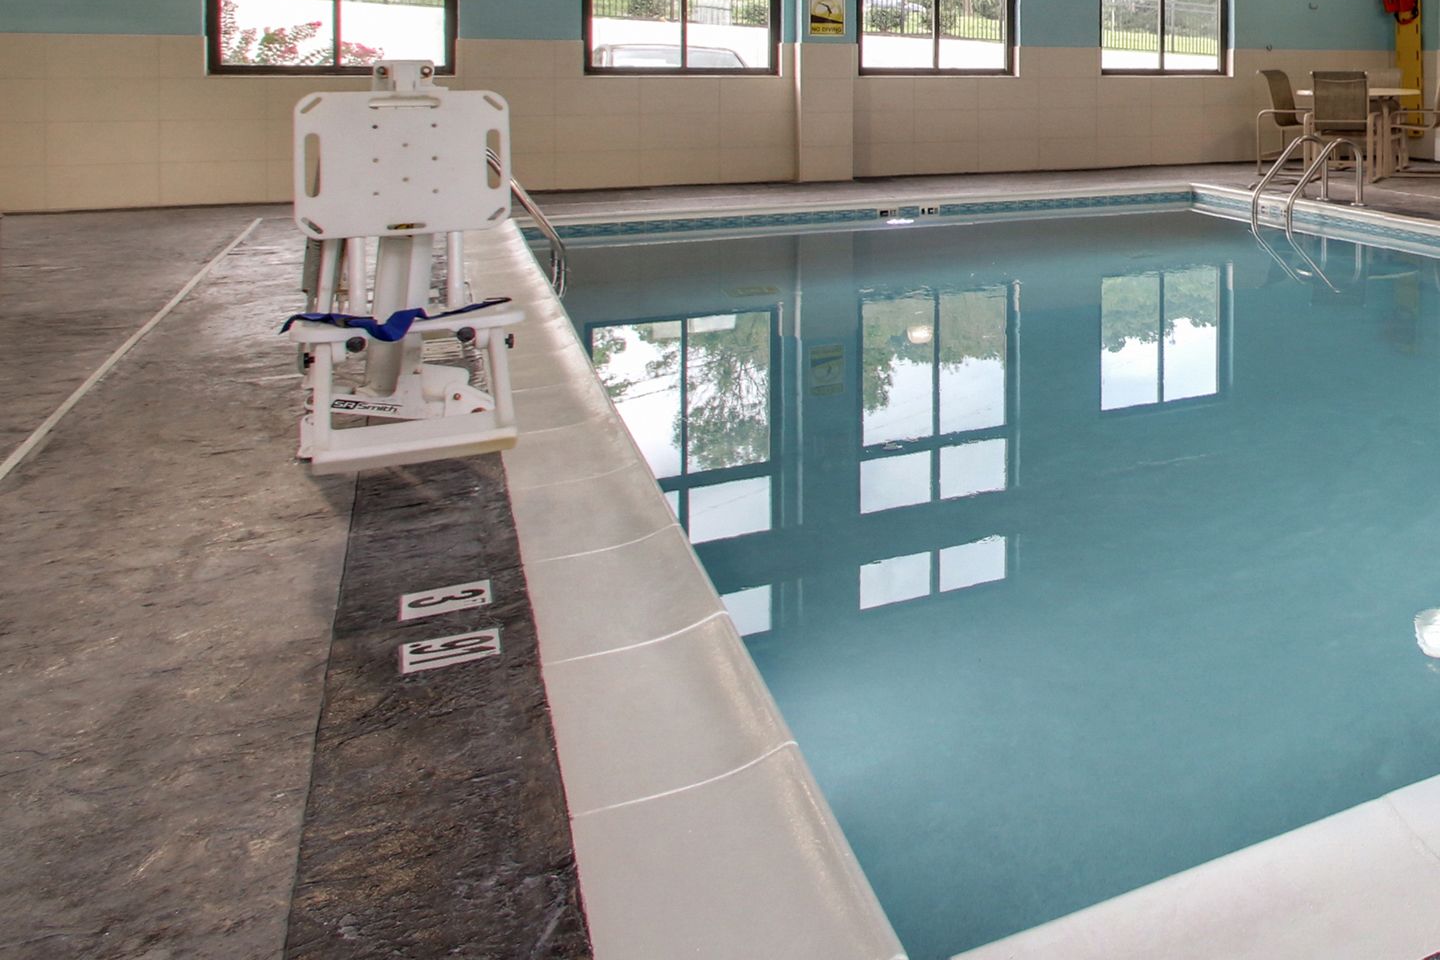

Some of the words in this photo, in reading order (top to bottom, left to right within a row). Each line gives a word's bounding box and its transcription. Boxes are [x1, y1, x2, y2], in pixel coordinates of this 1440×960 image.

[357, 402, 398, 413] Smith
[407, 589, 486, 609] 3
[408, 635, 496, 666] .91
